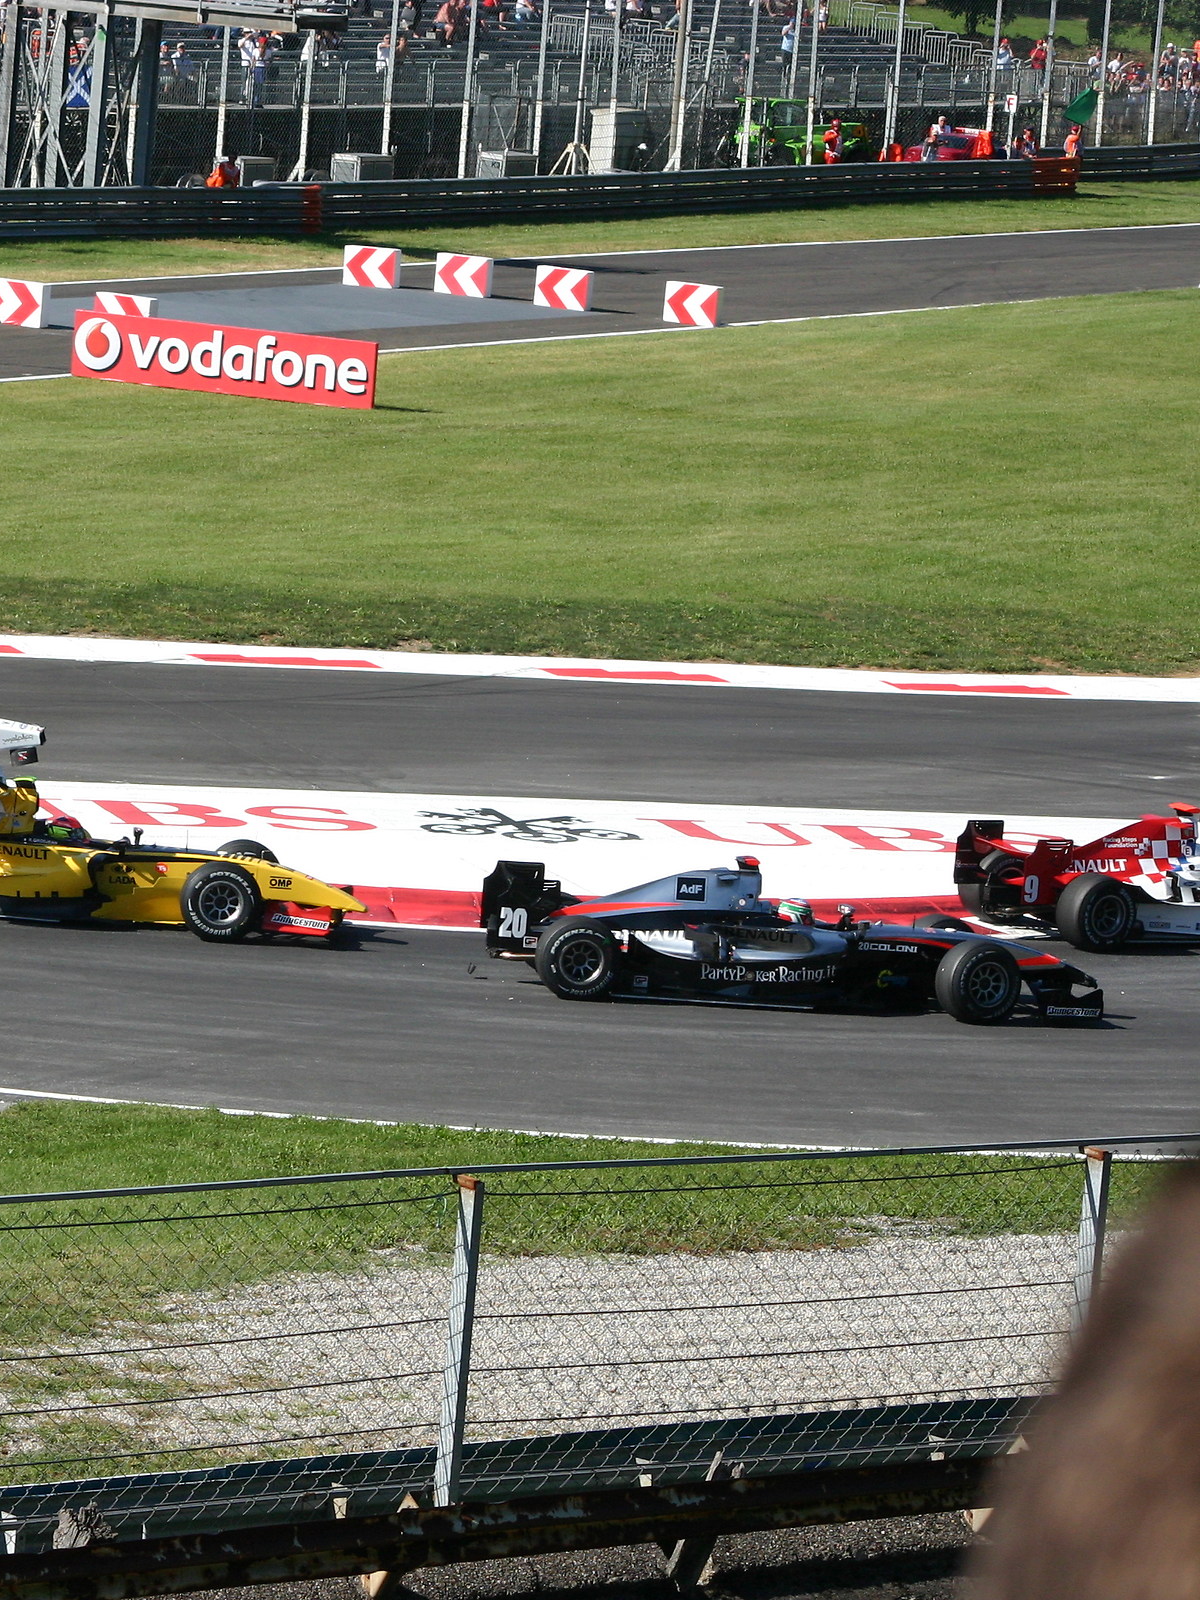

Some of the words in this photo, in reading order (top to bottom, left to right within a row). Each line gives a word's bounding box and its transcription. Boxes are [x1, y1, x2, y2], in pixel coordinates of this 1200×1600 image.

[128, 330, 368, 394] vodafone
[1062, 859, 1127, 874] ENAULT
[109, 875, 137, 885] LADA
[209, 871, 252, 894] POTENZA
[269, 878, 293, 888] OMP
[679, 883, 703, 895] AdF
[1024, 875, 1039, 903] 9
[272, 913, 330, 930] BRIDGESTONE
[498, 907, 528, 938] 20
[869, 943, 918, 953] COLONI
